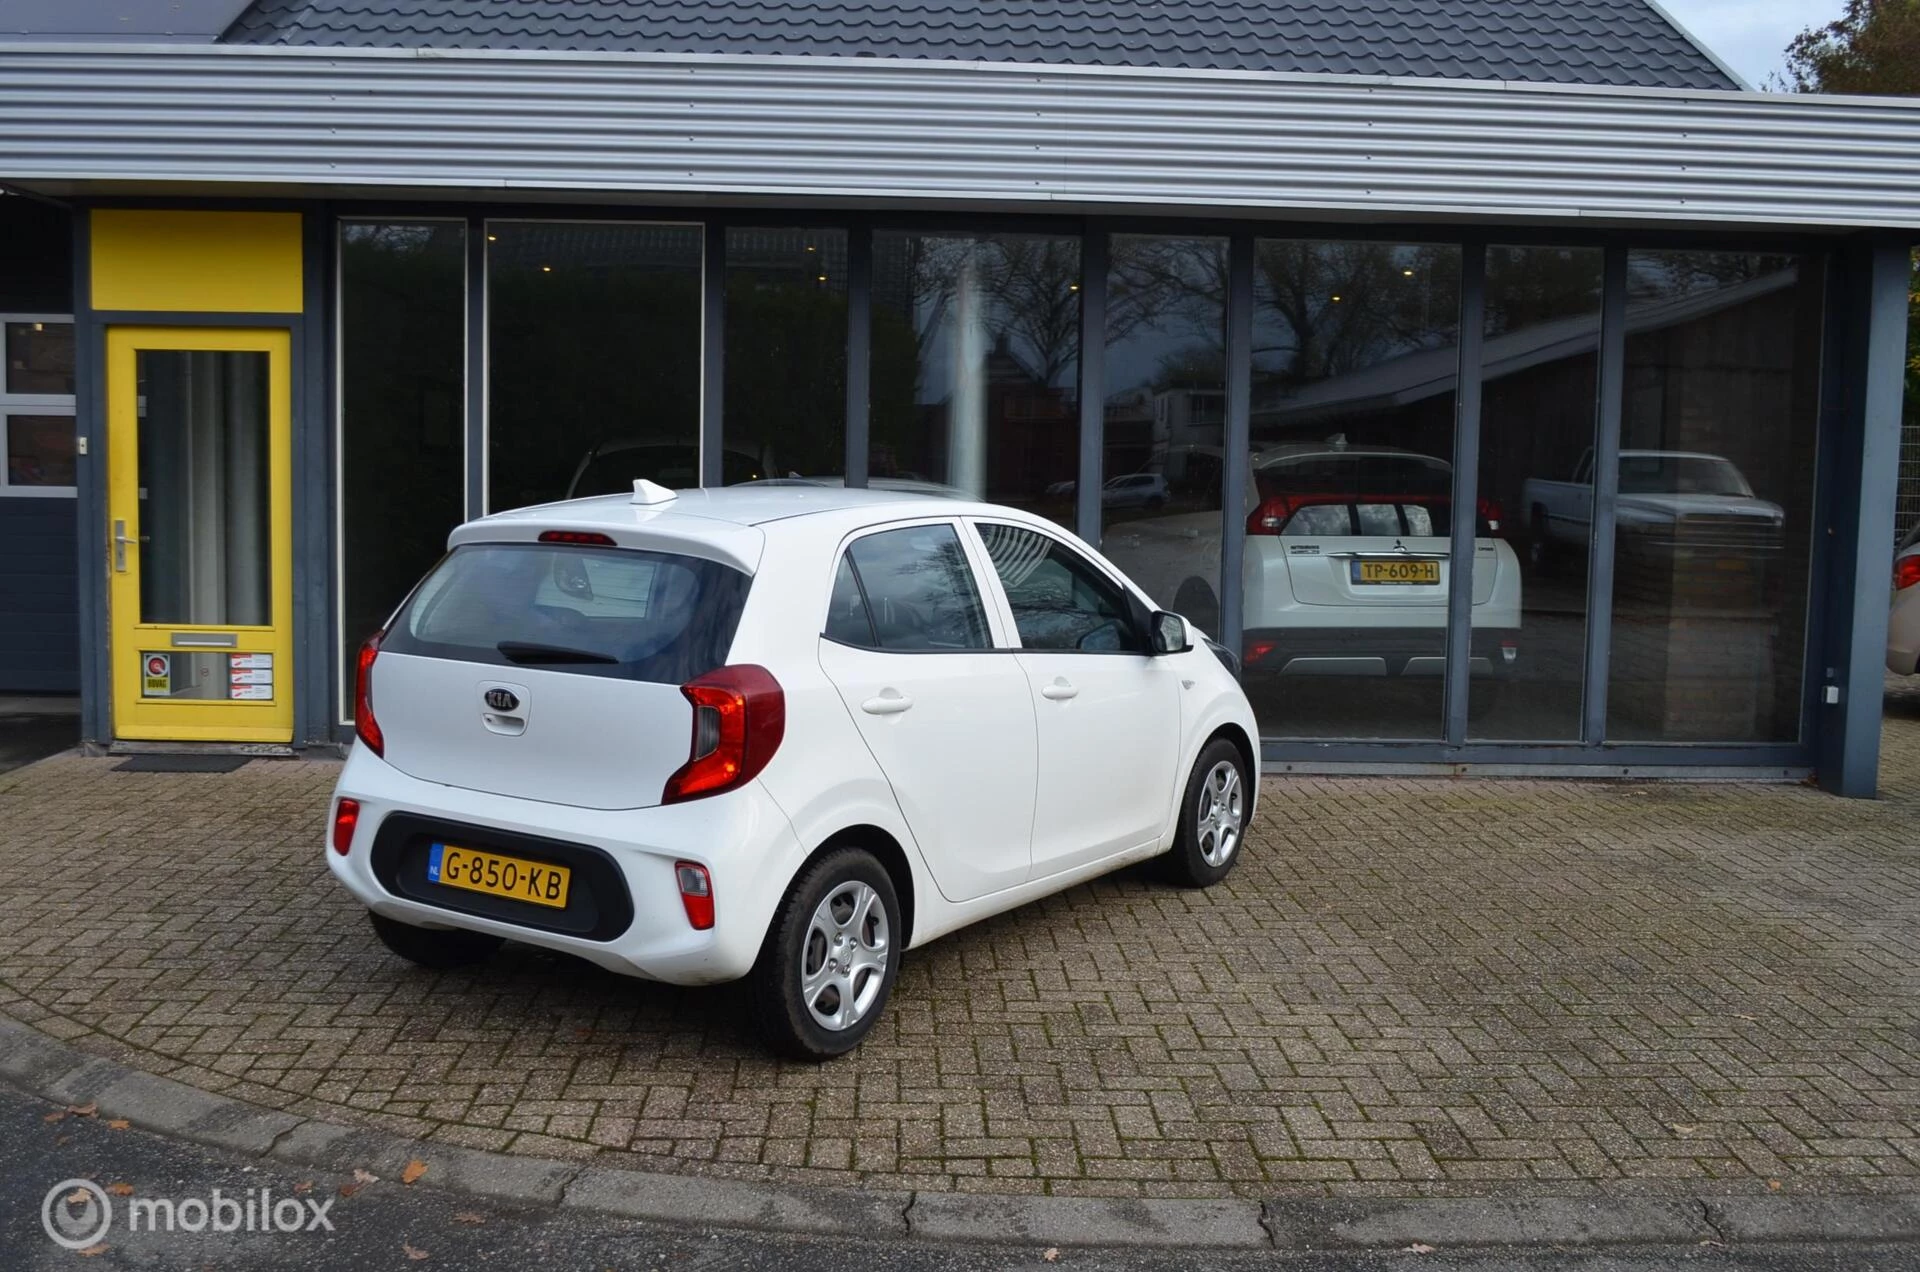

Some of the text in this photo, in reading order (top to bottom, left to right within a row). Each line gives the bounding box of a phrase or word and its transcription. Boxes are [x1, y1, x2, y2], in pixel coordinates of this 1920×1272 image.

[1364, 564, 1434, 579] TP-609-H
[489, 691, 512, 708] KIA
[429, 852, 562, 900] NL G-850-KB
